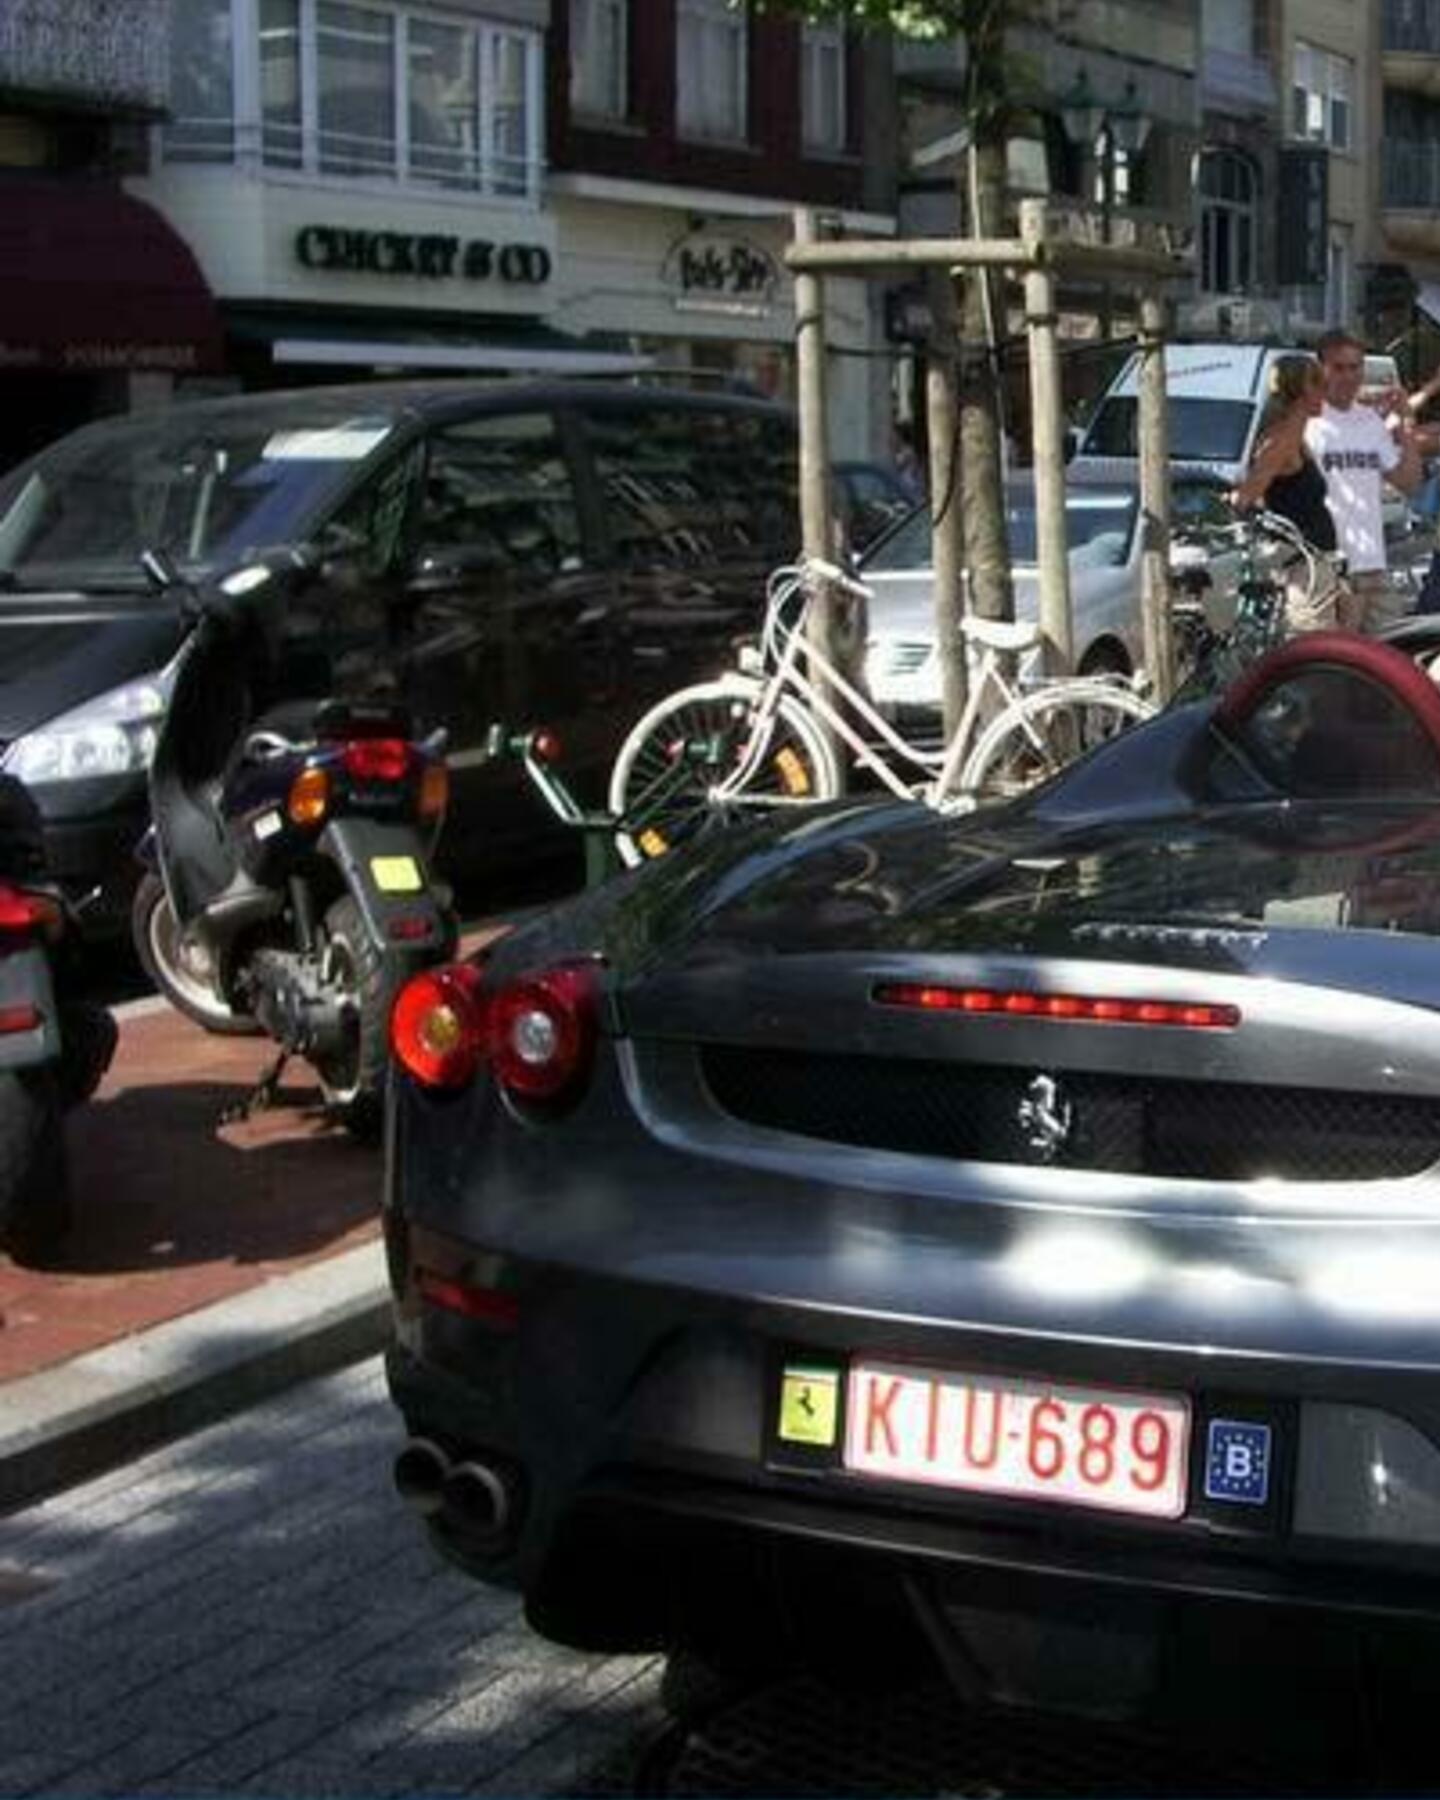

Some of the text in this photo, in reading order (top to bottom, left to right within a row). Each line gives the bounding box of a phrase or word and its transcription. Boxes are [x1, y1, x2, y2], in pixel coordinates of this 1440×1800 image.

[500, 244, 551, 284] CO
[865, 1374, 1170, 1491] KIU-689
[1226, 1444, 1251, 1478] B
